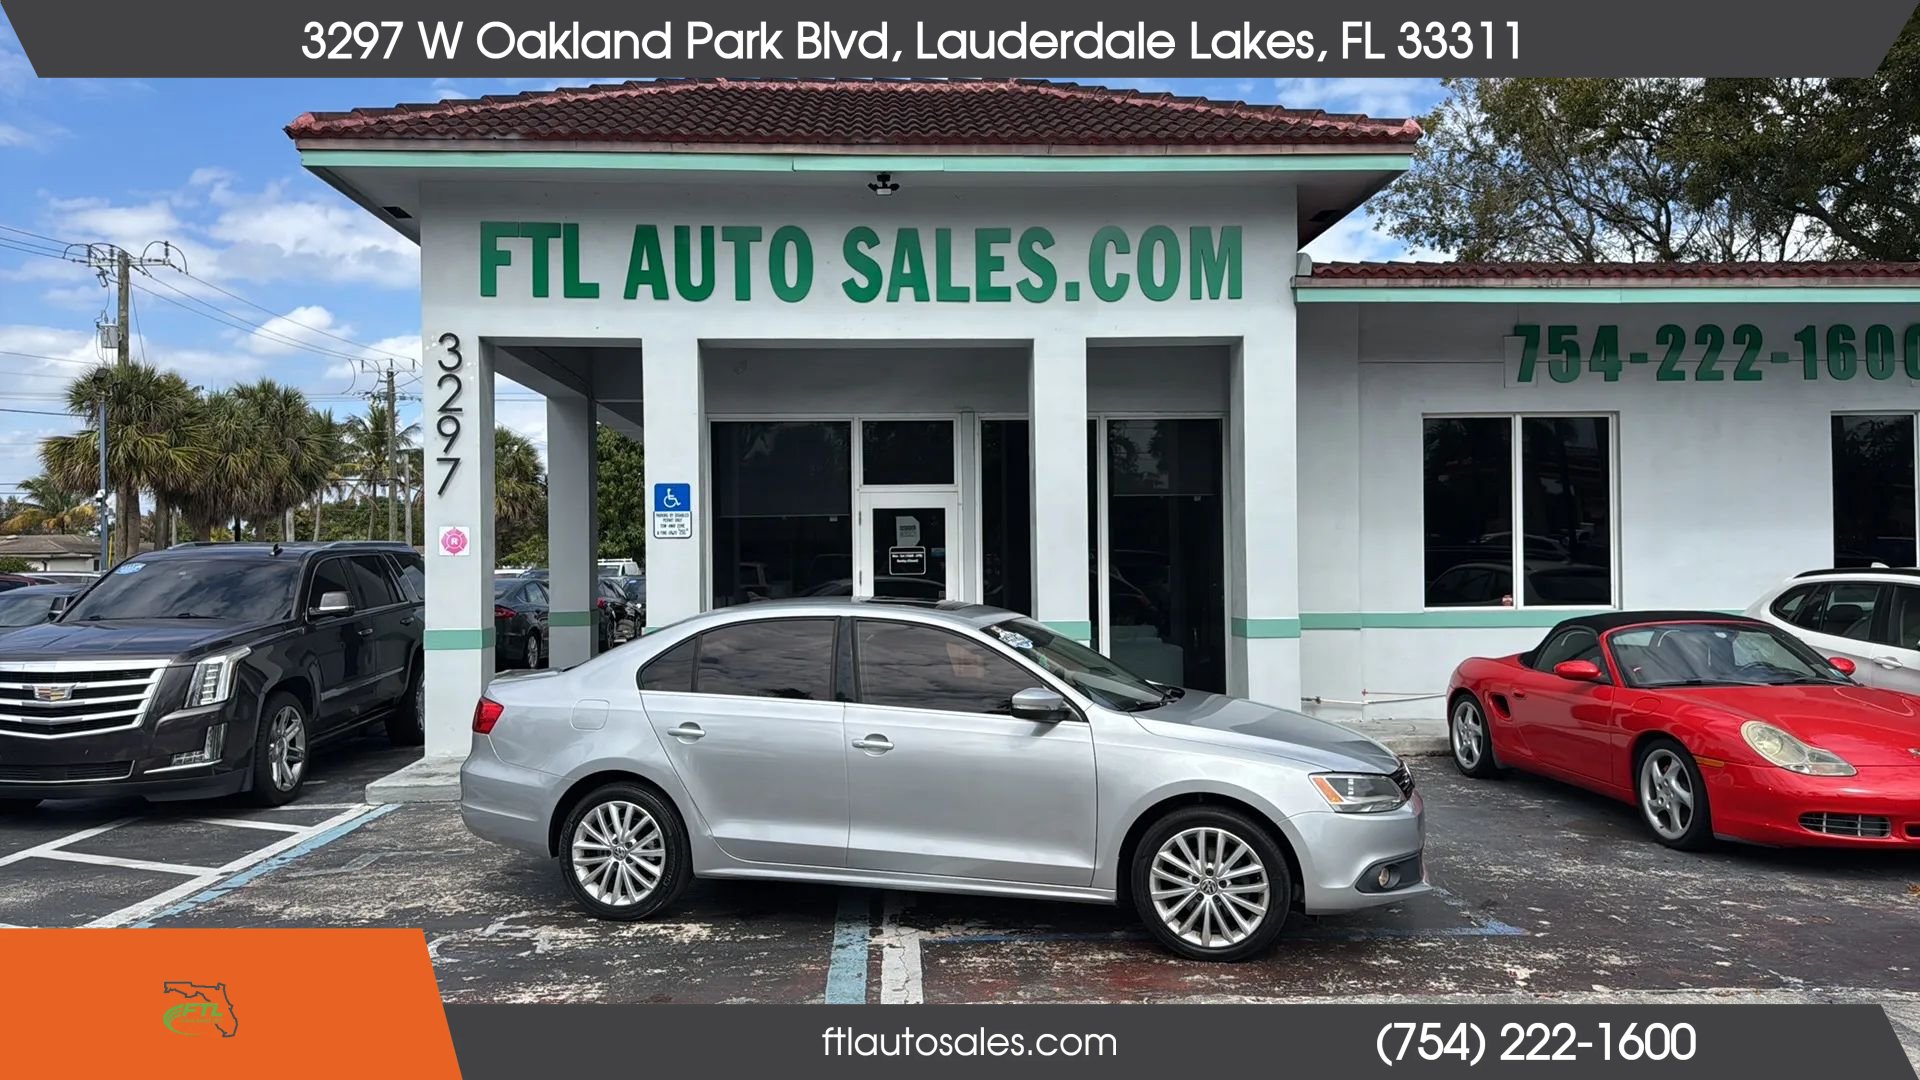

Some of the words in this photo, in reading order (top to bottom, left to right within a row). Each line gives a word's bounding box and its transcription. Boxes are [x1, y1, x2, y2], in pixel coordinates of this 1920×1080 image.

[480, 222, 600, 299] FTL
[623, 226, 814, 303] AUTO
[842, 226, 1243, 304] SALES.COM
[437, 332, 463, 496] 3297
